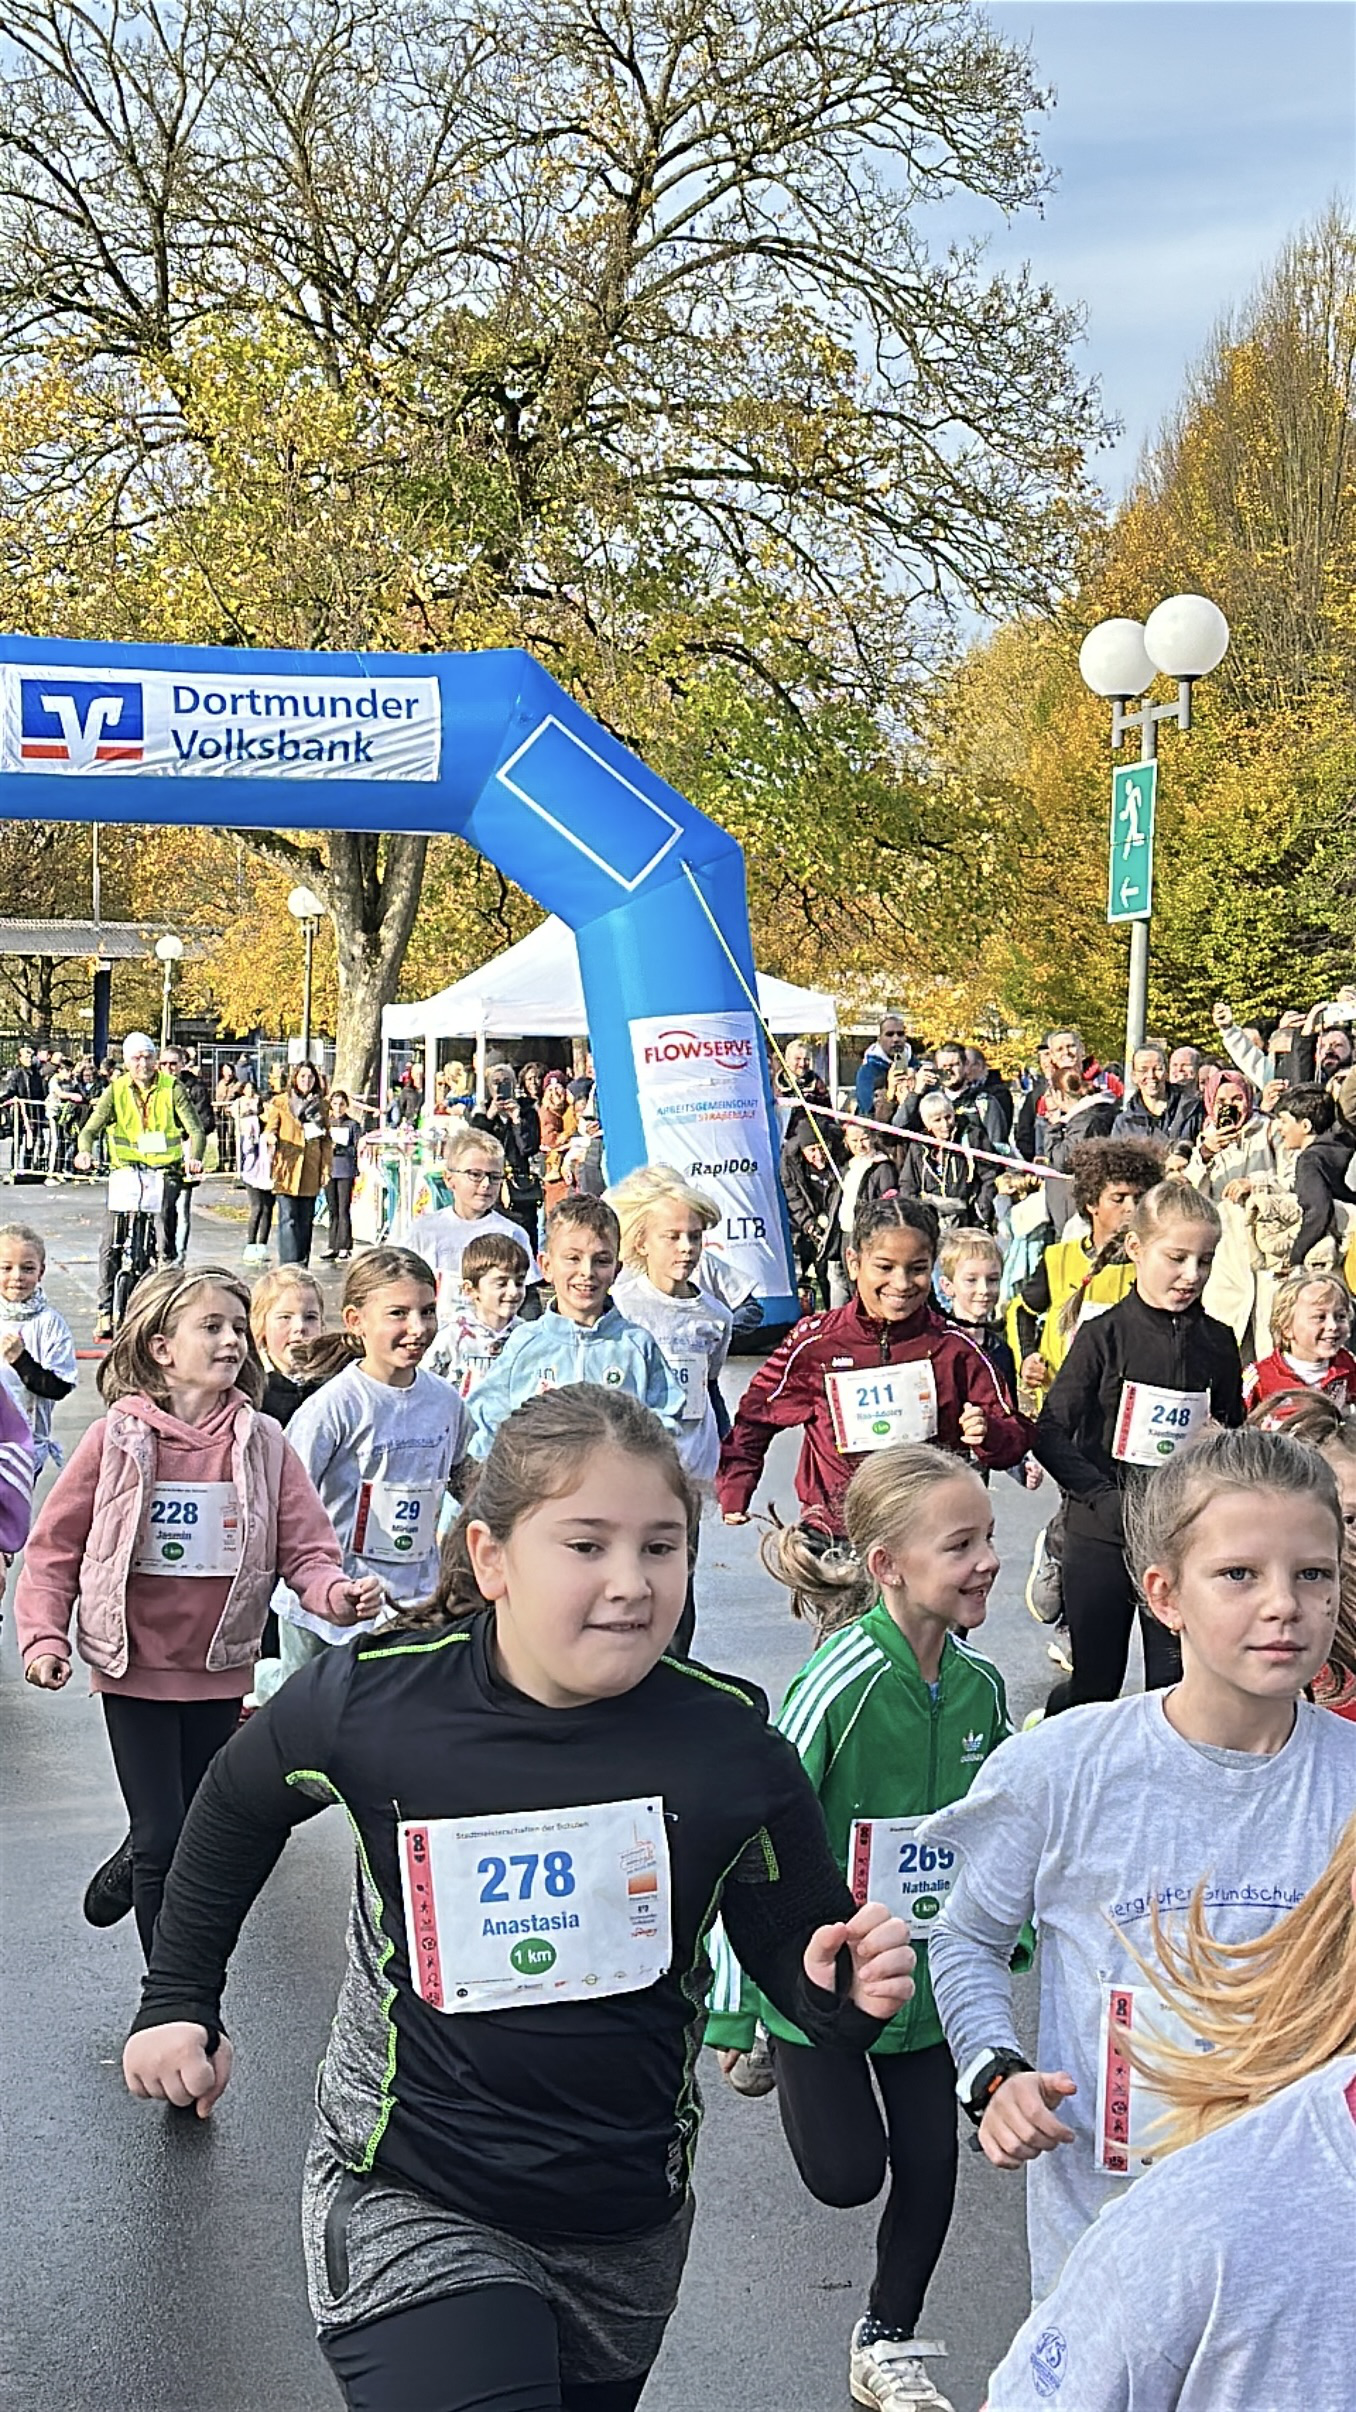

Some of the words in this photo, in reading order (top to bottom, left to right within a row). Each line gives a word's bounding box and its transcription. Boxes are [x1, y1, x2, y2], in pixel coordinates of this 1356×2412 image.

[173, 685, 419, 719] Dortmunder
[171, 729, 374, 763] Volksbank
[644, 1040, 752, 1064] FLOWSERVE
[727, 1217, 766, 1240] LTB
[856, 1384, 894, 1406] 211
[1151, 1405, 1191, 1426] 248
[151, 1501, 198, 1524] 228
[395, 1501, 420, 1520] 29
[898, 1843, 954, 1874] 269
[477, 1851, 575, 1903] 278
[902, 1879, 951, 1895] Nathalie
[482, 1911, 580, 1937] Anastasia
[514, 1950, 523, 1965] 1
[527, 1947, 552, 1963] km
